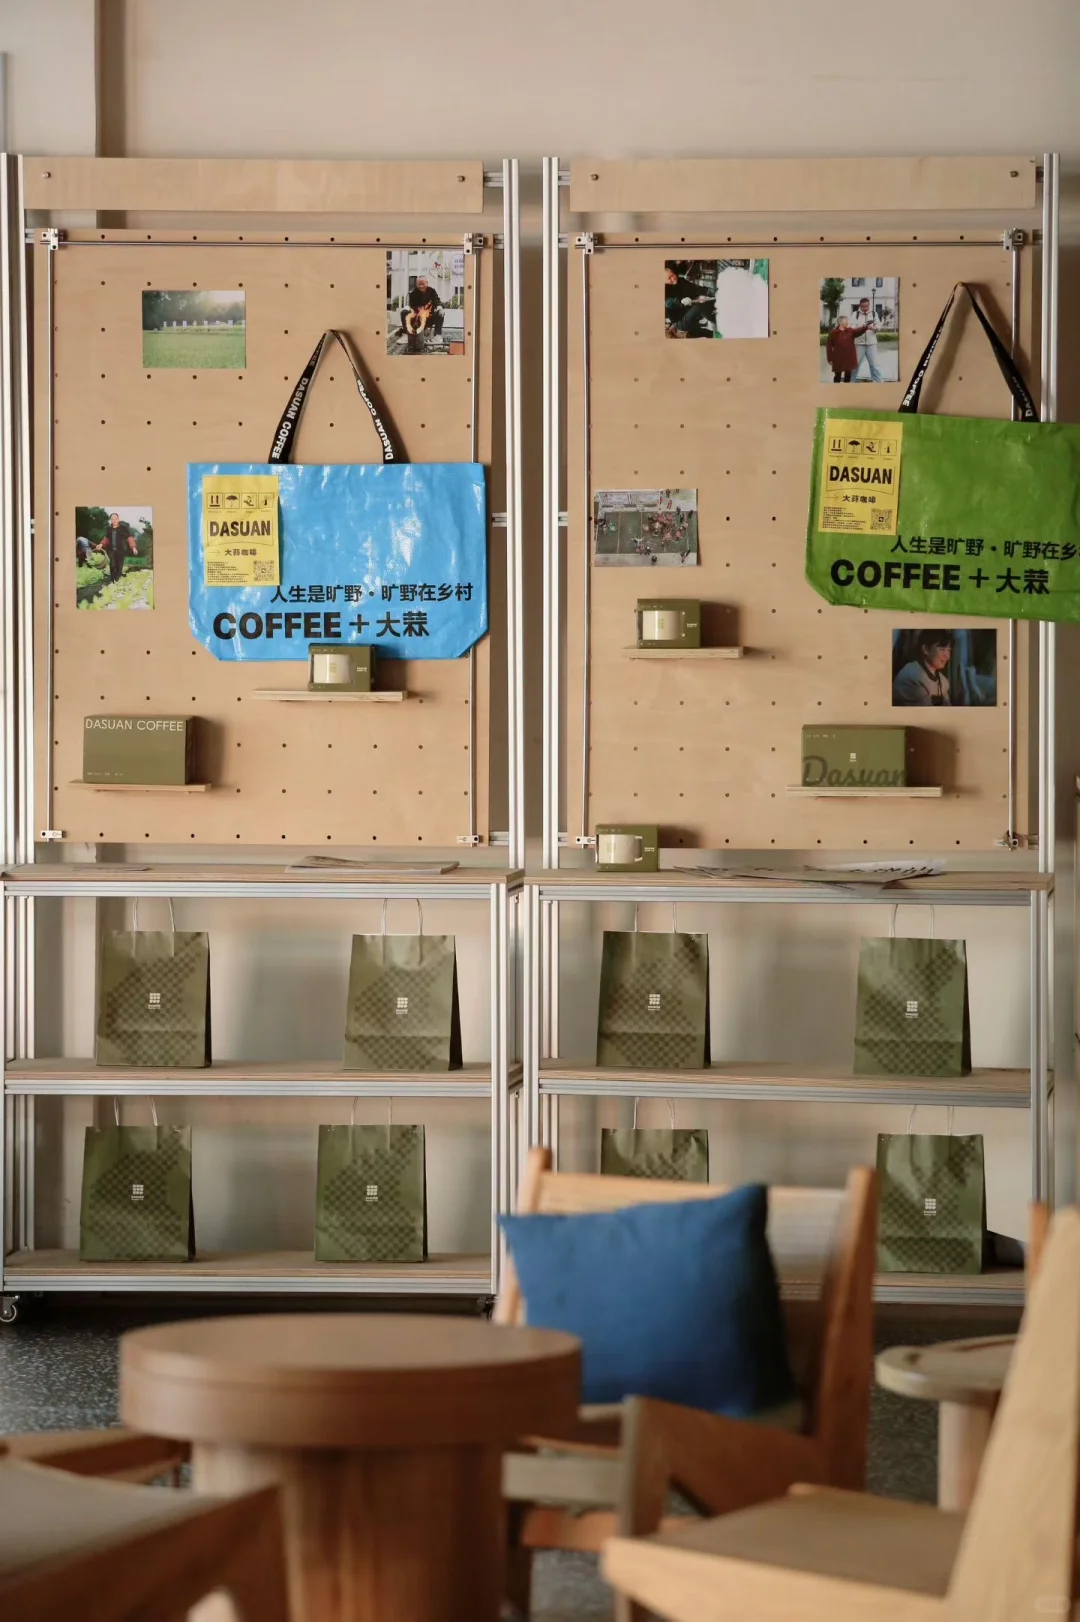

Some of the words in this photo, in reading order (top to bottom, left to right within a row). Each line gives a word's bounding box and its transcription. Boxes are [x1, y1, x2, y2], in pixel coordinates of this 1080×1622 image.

[286, 377, 308, 420] DASUAN
[356, 379, 377, 416] COFFEE
[902, 369, 924, 407] COFFEE
[271, 421, 292, 459] COFFEE
[374, 418, 394, 460] DASUAN
[829, 465, 892, 484] DASUAN
[209, 520, 271, 537] DASUAN
[890, 535, 1080, 561] 人生是旷野·旷野在乡
[830, 559, 961, 591] COFFEE
[996, 568, 1050, 594] 大蒜
[213, 611, 342, 640] COFFEE
[376, 611, 430, 637] 大蒜
[85, 718, 133, 730] DASUAN
[136, 720, 184, 732] COFFEE
